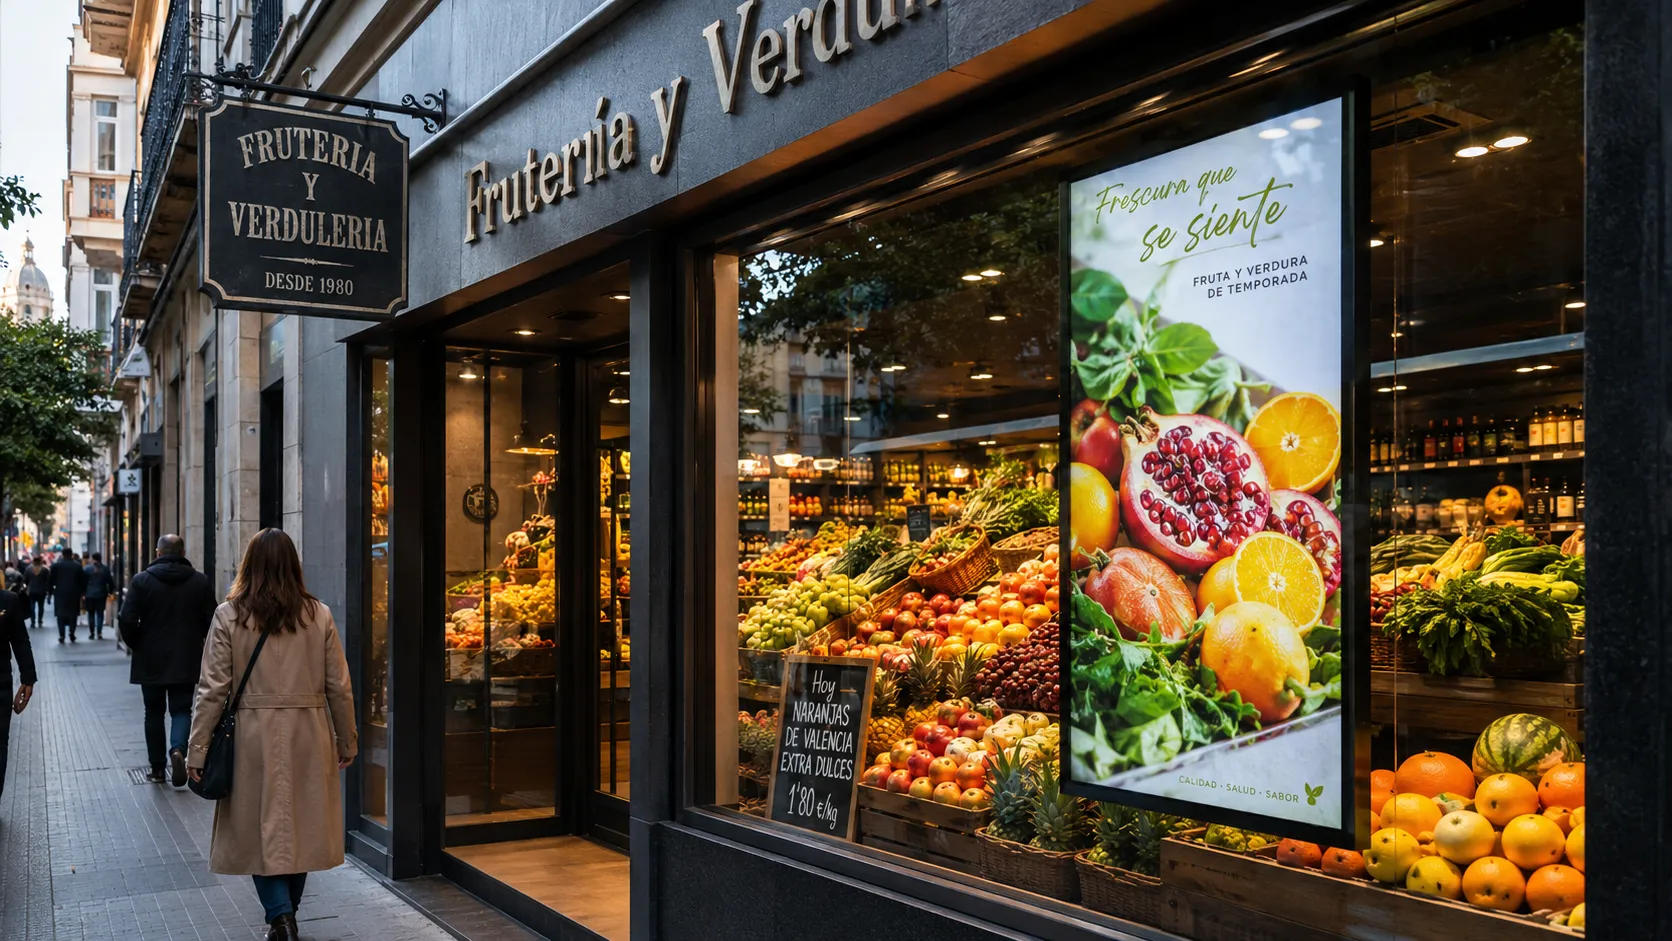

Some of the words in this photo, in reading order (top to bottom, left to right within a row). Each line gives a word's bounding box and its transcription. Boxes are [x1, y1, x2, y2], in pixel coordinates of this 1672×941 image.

[650, 76, 685, 175] y
[702, 0, 940, 114] Verdu
[237, 127, 376, 185] FRUTERIA
[302, 172, 320, 201] Y
[1095, 183, 1190, 224] Frescura
[1197, 166, 1237, 206] que
[228, 201, 389, 253] VERDULERIA
[1139, 224, 1177, 263] se
[1184, 177, 1293, 253] siente
[265, 271, 314, 292] DESDE
[319, 277, 354, 296] 1980
[1193, 271, 1230, 288] FRUTA
[1235, 268, 1242, 279] Y
[1246, 255, 1308, 277] VERDURA
[1207, 287, 1223, 299] DE
[1228, 271, 1308, 295] TEMPORADA
[812, 669, 836, 703] Hoy
[793, 701, 851, 727] NARANJAS
[785, 726, 800, 748] DE
[804, 727, 853, 754] VALENCIA
[780, 751, 812, 776] EXTRA
[815, 755, 853, 781] DULCES
[1179, 775, 1217, 789] CALIDAD
[1226, 783, 1256, 796] SALUD
[1265, 790, 1299, 803] SABOR
